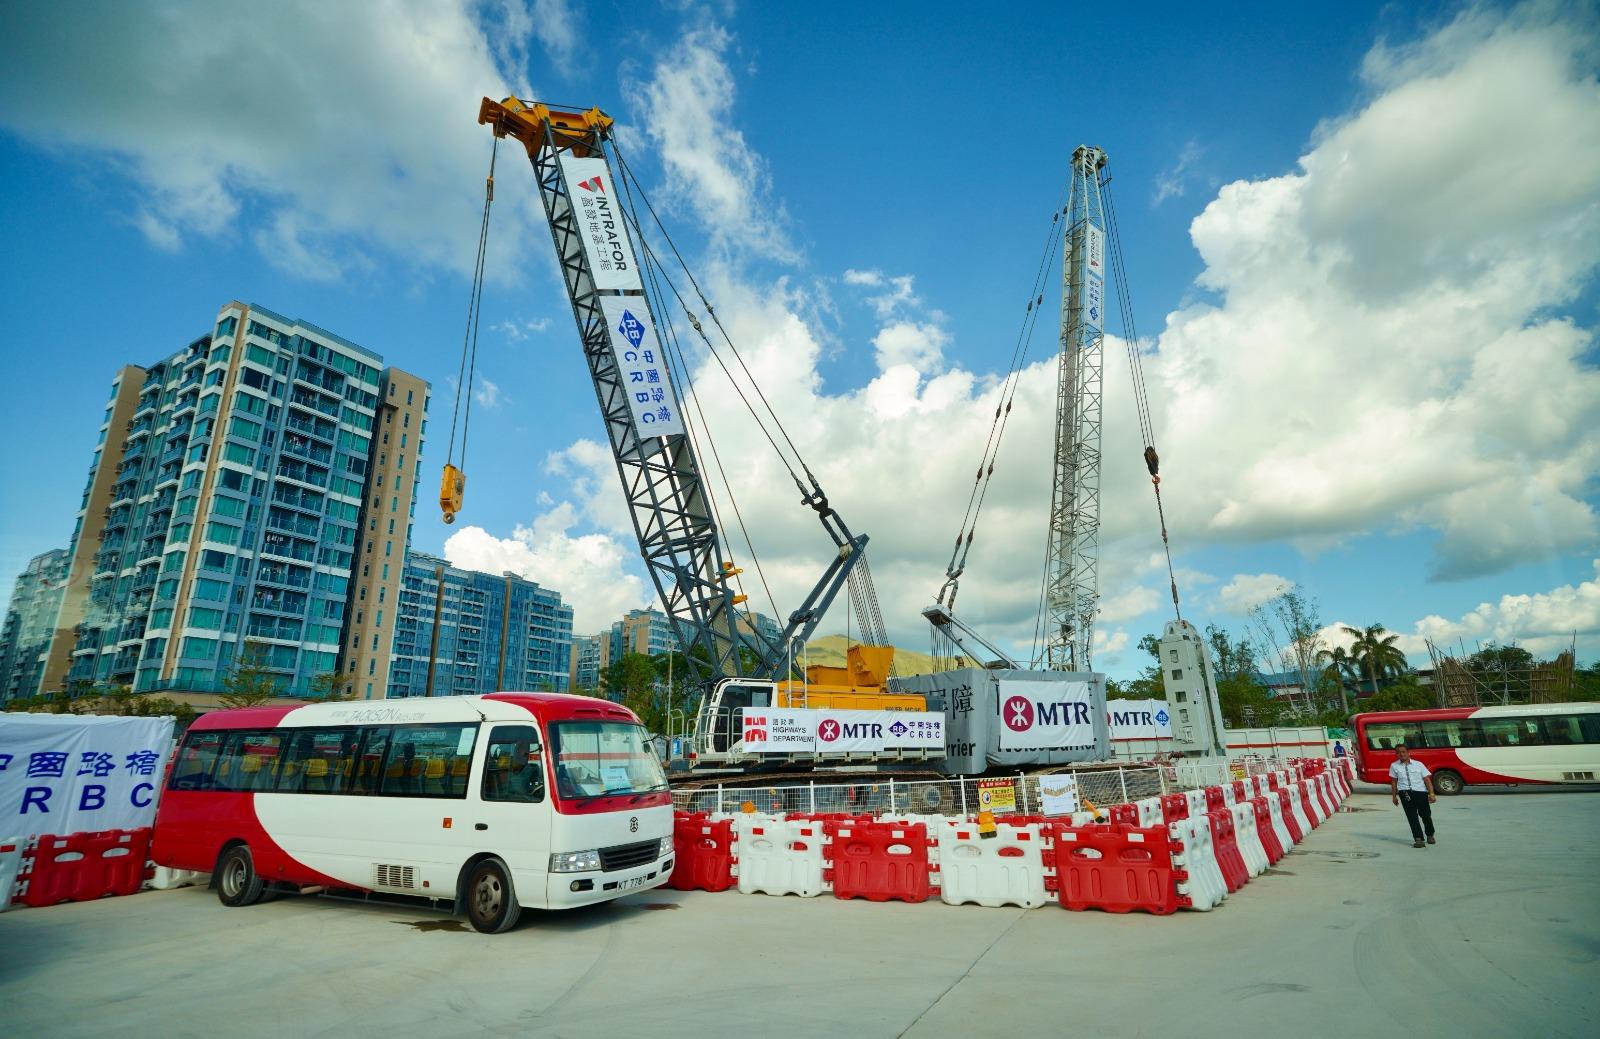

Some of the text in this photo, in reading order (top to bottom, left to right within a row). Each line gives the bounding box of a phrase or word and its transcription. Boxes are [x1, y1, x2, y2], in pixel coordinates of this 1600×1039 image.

[595, 196, 627, 271] INTRAFOR
[642, 350, 672, 422] 中國路橋
[1037, 701, 1091, 726] MTR
[1113, 711, 1153, 726] MTR
[772, 726, 807, 734] HIGHWAYS
[842, 723, 883, 739] MTR
[772, 735, 815, 743] DEPARTMENT
[619, 875, 647, 890] KT 7787
